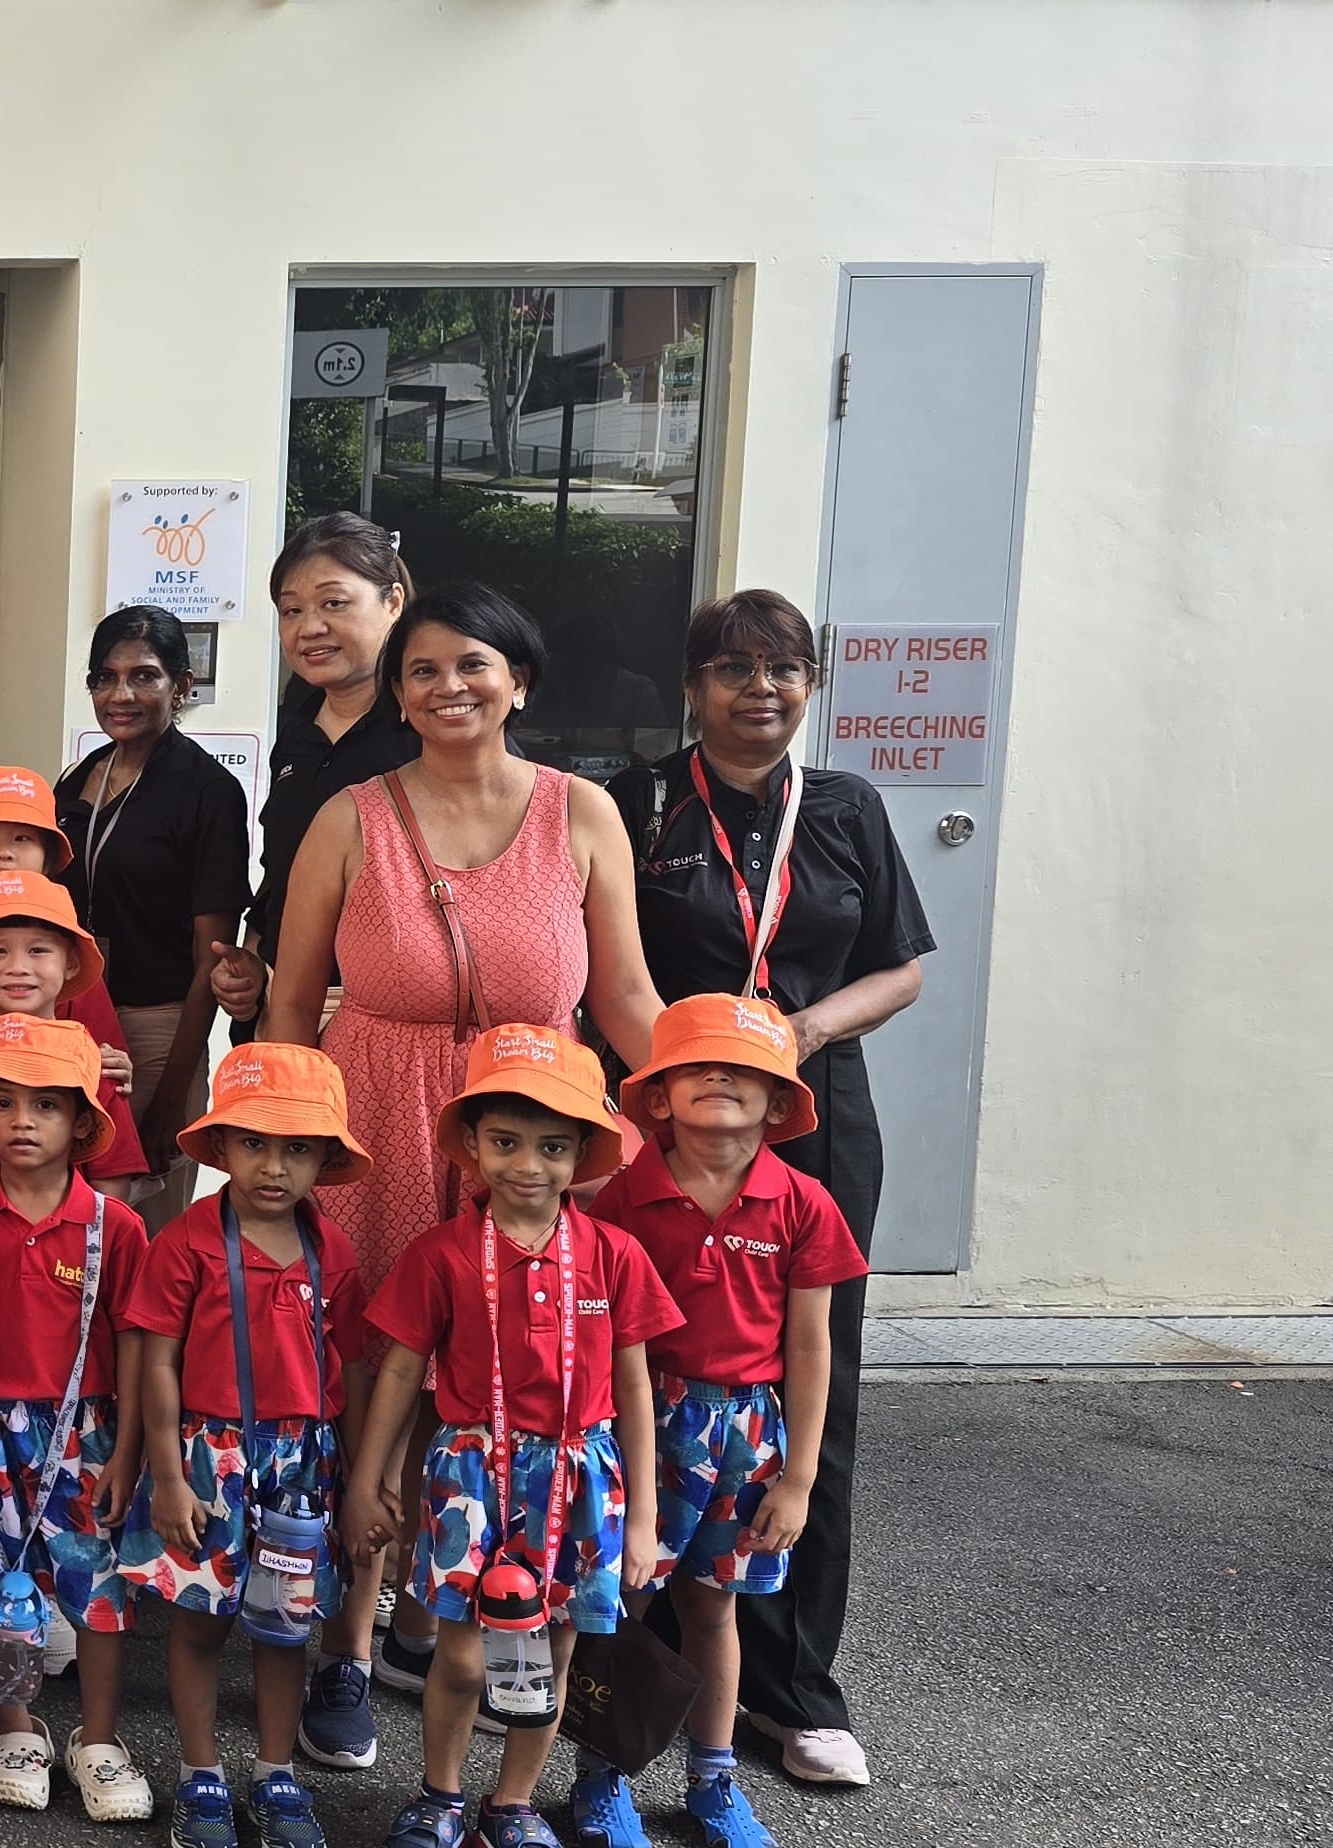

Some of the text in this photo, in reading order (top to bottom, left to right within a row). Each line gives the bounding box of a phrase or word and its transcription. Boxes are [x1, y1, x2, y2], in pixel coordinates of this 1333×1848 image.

[142, 486, 219, 498] Supported by:
[155, 570, 200, 584] MSF
[148, 586, 206, 594] MINISTRY OF
[131, 596, 221, 604] SOCIAL AND FAMILY
[162, 606, 209, 614] LOPMENT
[844, 637, 988, 662] DRY RISER
[835, 715, 986, 739] BREECHING
[870, 746, 946, 771] INLET
[667, 852, 703, 867] TOUCH
[494, 1035, 522, 1051] Start
[492, 1047, 556, 1065] Dream Big
[236, 1058, 264, 1073] Small
[240, 1070, 264, 1089] Big
[746, 1239, 781, 1254] TOUCH
[576, 1299, 610, 1309] TOUC
